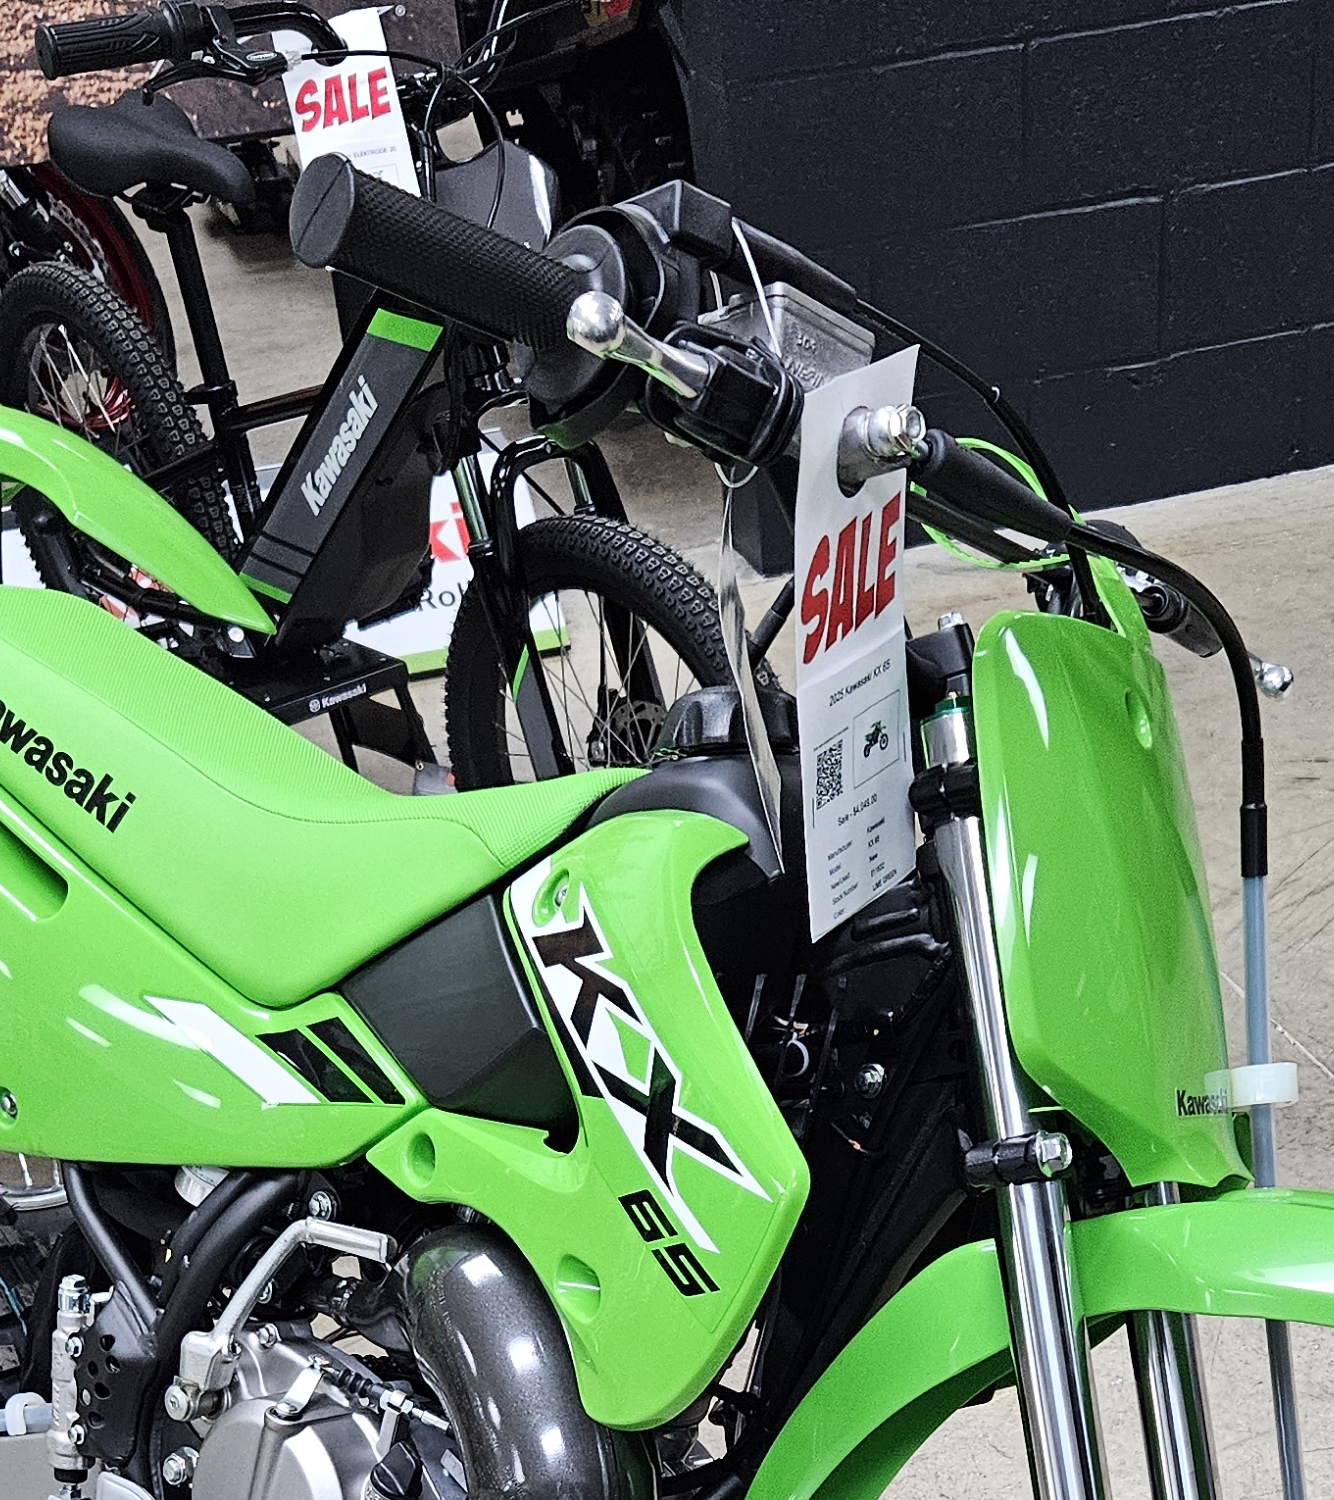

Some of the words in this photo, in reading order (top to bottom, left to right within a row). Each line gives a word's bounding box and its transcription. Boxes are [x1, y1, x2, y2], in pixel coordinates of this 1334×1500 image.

[295, 67, 391, 132] SALE
[302, 376, 378, 517] Kawasaki
[801, 493, 900, 665] SALE
[321, 682, 367, 708] Kawasaki
[829, 692, 845, 707] 2025
[845, 671, 873, 696] Kawasaki
[873, 667, 882, 680] KX
[531, 903, 759, 1200] KX
[618, 1189, 719, 1298] 65
